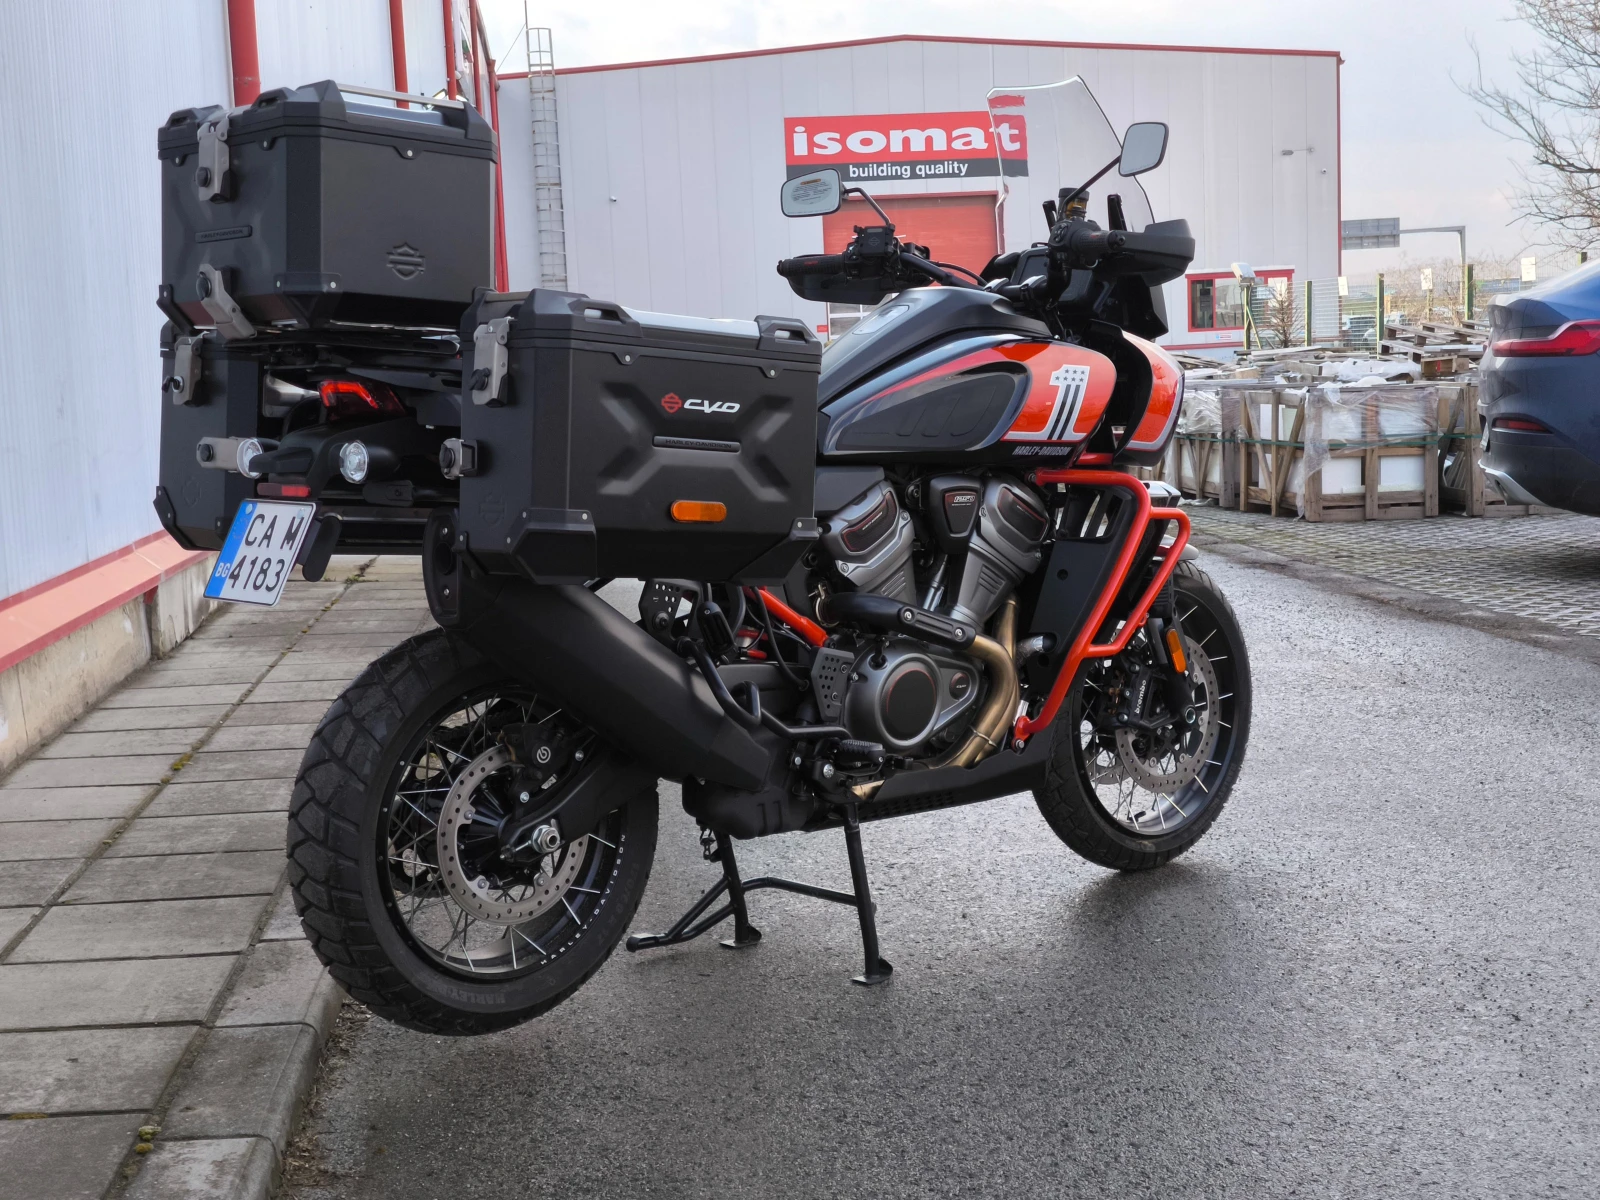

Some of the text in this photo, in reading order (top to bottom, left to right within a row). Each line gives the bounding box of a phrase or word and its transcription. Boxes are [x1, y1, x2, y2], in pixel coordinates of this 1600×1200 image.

[793, 125, 1021, 156] isomat
[849, 161, 969, 178] building quality
[683, 398, 741, 414] CVO
[665, 438, 732, 449] HARLEY-DAVIDSON
[1011, 445, 1074, 456] HARLEY-DAVIDSON
[244, 513, 305, 551] CA M
[214, 562, 231, 578] BG
[228, 555, 286, 592] 4183
[1133, 679, 1147, 714] brembo
